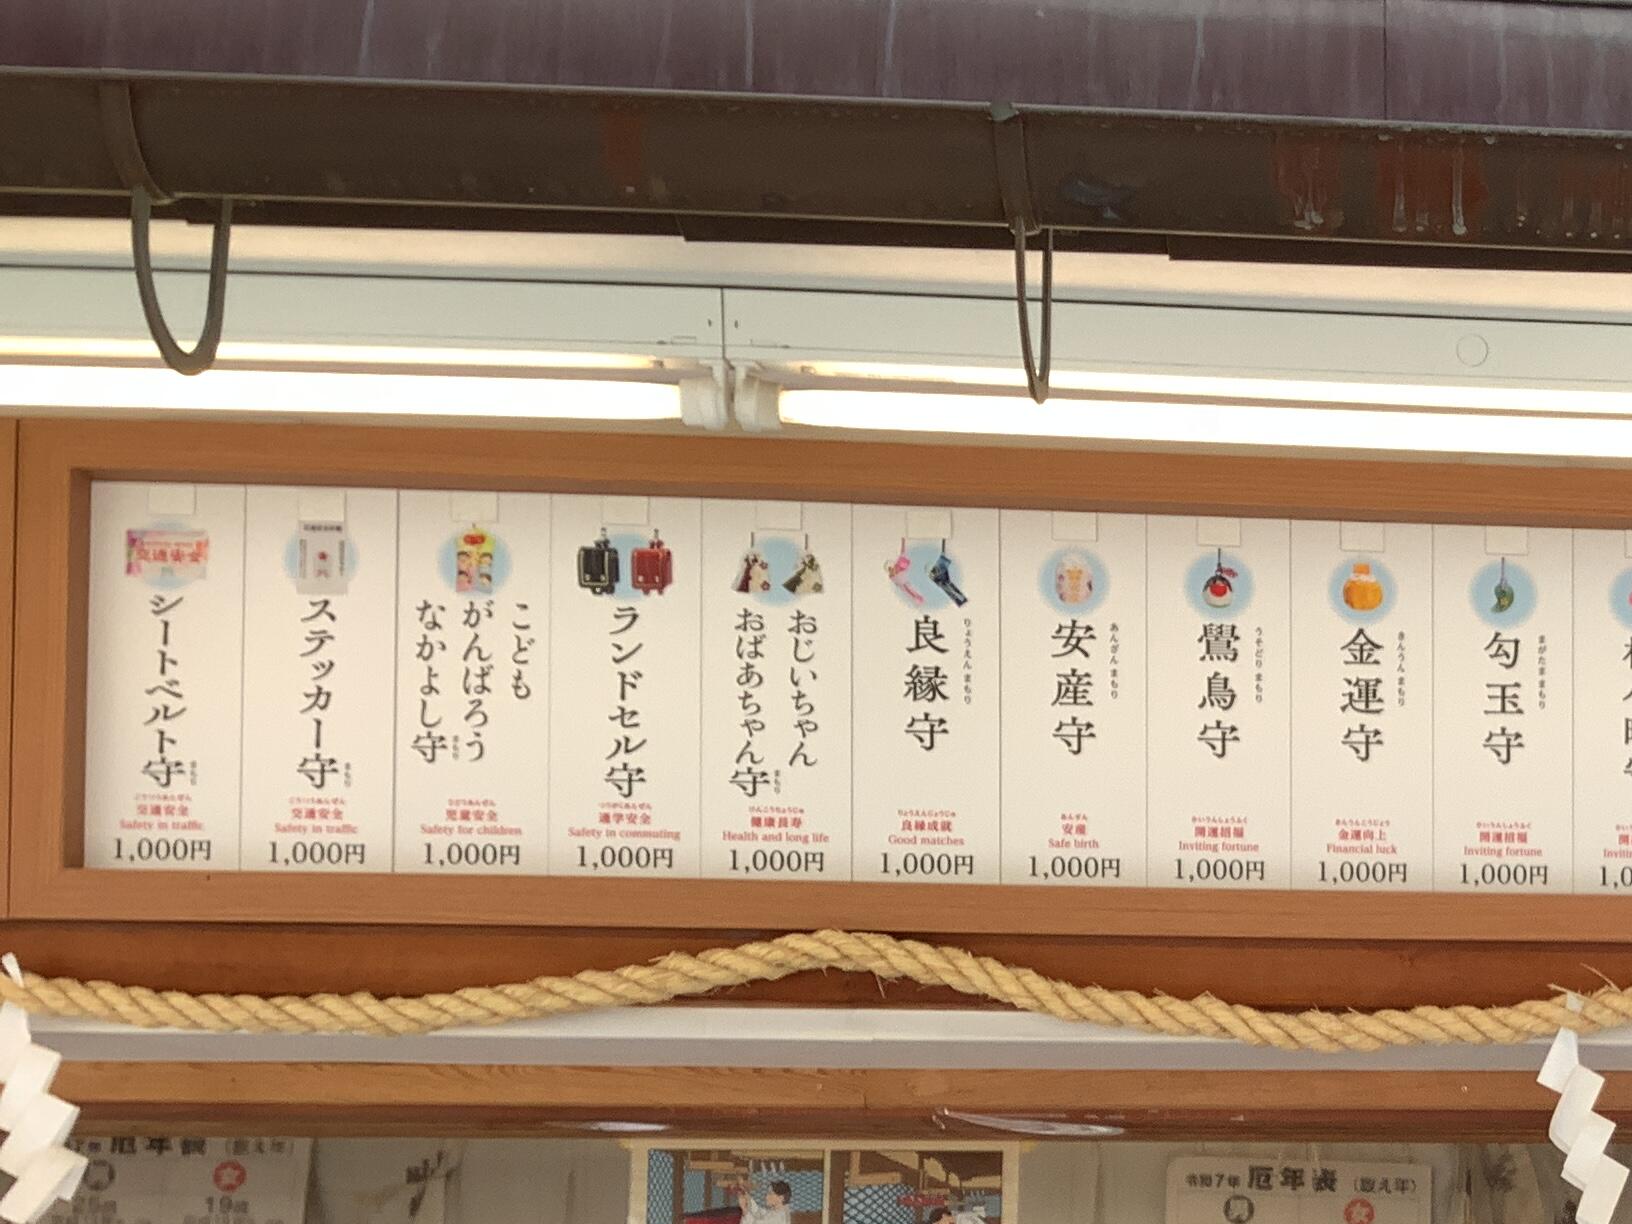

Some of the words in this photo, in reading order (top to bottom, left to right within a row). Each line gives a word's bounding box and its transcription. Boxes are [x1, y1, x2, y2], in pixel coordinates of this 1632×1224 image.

[512, 604, 535, 699] こども
[142, 595, 186, 787] シートベルト守
[412, 600, 448, 763] なかよし守
[463, 600, 494, 761] がんばろう
[788, 610, 818, 766] おじいちゃん
[904, 615, 949, 751] 良縁守
[1051, 619, 1096, 755] 安産守
[297, 599, 338, 789] ステッカー守
[605, 607, 647, 798] ランドセル守
[729, 608, 770, 797] おばあちゃん守
[1341, 628, 1384, 762] 金運守
[1483, 632, 1524, 764] 勾玉守
[137, 805, 188, 816] 交通安全
[292, 808, 342, 820] 交通安全
[599, 813, 650, 824] 通学安全
[751, 812, 803, 828] 健康長寿
[119, 819, 158, 830] Safety
[160, 822, 168, 830] in
[171, 821, 204, 830] traffic
[274, 823, 309, 834] Safety
[312, 824, 322, 833] in
[325, 824, 358, 834] traffic
[420, 824, 454, 835] Safety
[458, 825, 473, 834] for
[476, 825, 522, 835] children
[568, 827, 602, 839] Safety
[605, 829, 616, 838] in
[619, 830, 681, 841] commuting
[902, 816, 952, 832] 良縁成就
[1063, 820, 1087, 835] 安産
[1195, 826, 1244, 838] 開運招福
[1339, 829, 1385, 841] 金運向上
[722, 831, 754, 841] Health
[757, 833, 779, 842] and
[782, 832, 809, 844] long
[811, 833, 829, 843] life
[888, 835, 916, 845] Good
[919, 836, 964, 846] matches
[1048, 839, 1070, 848] Safe
[1073, 839, 1099, 848] birth
[1178, 841, 1219, 853] Inviting
[1222, 842, 1259, 852] fortune
[1326, 844, 1371, 854] Financial
[1375, 844, 1398, 854] luck
[1480, 832, 1527, 843] 開運招福
[115, 838, 210, 863] 1,000円
[270, 842, 365, 866] 1,000円
[425, 843, 520, 866] 1,000円
[579, 846, 672, 870] 1,000円
[732, 850, 824, 873] 1,000円
[1464, 846, 1502, 858] Inviting
[1505, 846, 1543, 856] fortune
[882, 853, 973, 877] 1,000円
[1030, 856, 1120, 880] 1,000円
[1176, 859, 1264, 882] 1,000円
[1320, 862, 1407, 885] 1,000円
[1462, 864, 1547, 886] 1,000円
